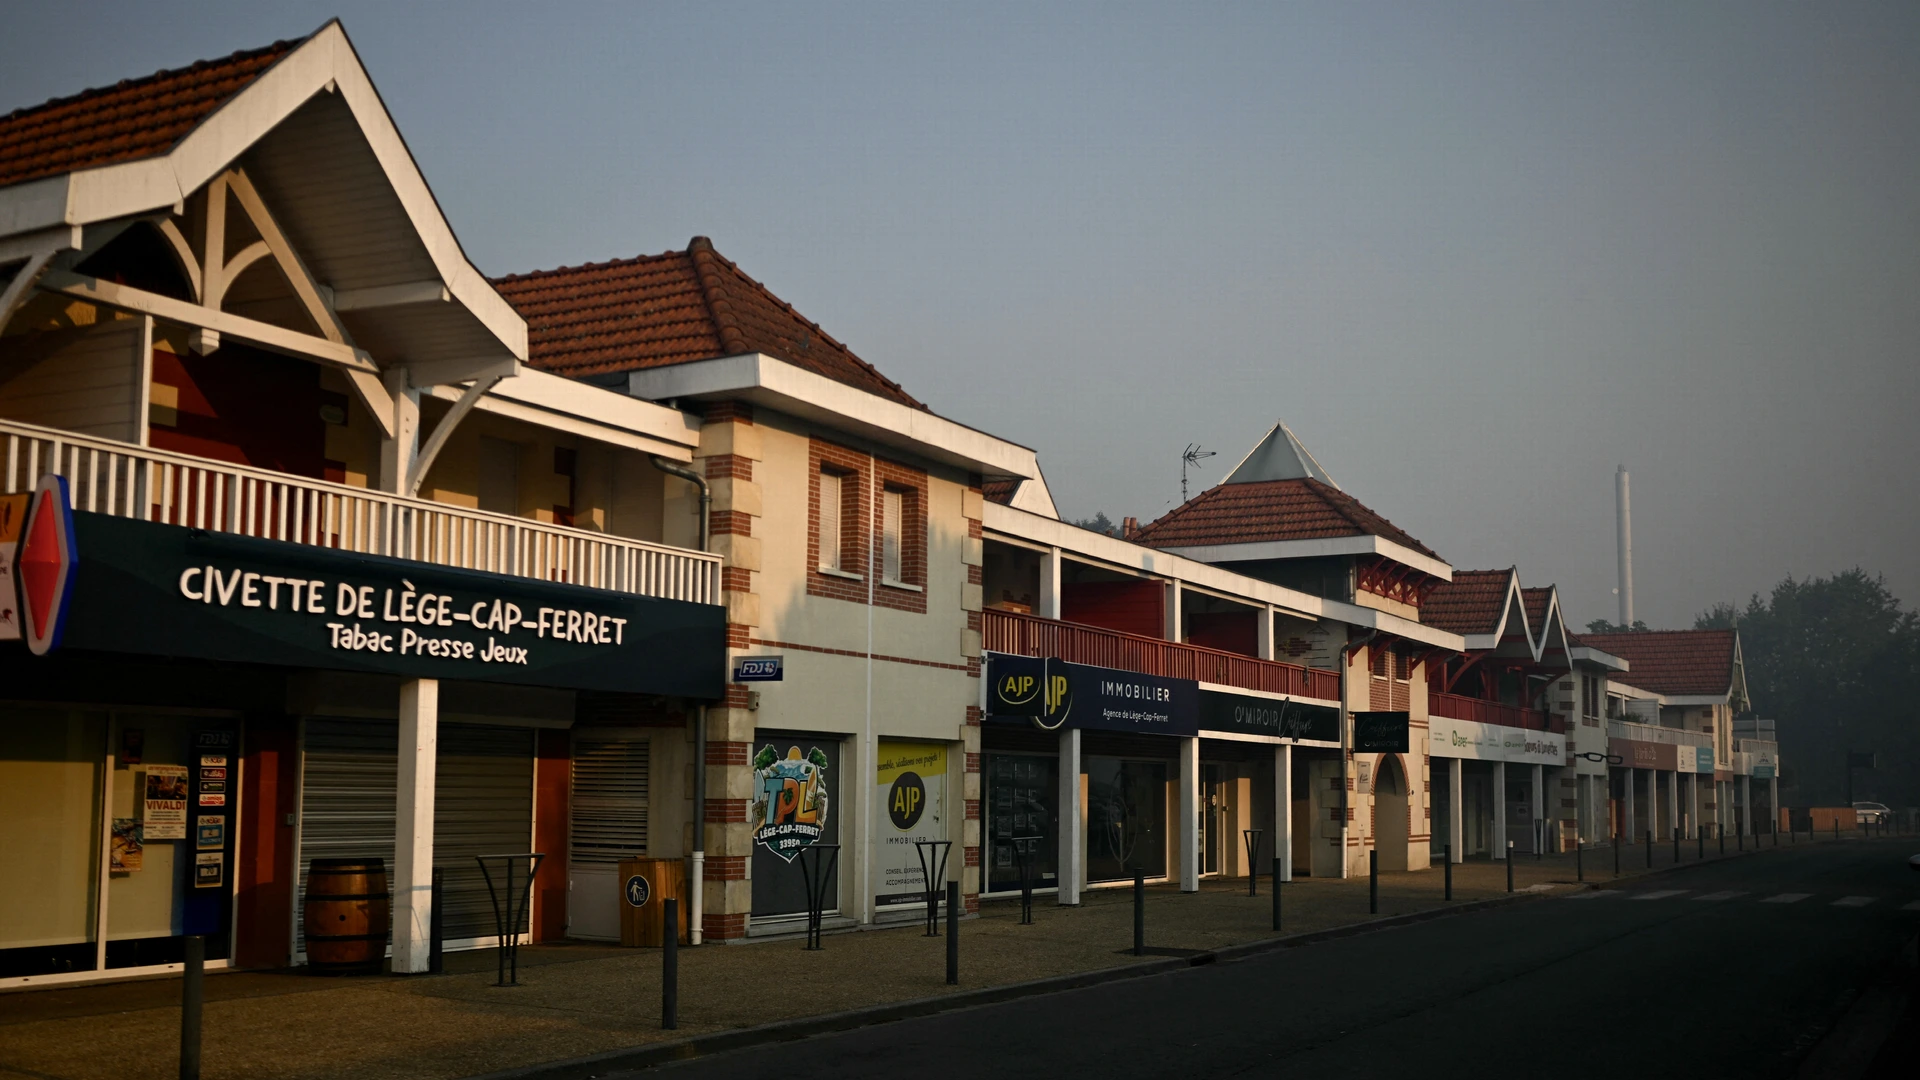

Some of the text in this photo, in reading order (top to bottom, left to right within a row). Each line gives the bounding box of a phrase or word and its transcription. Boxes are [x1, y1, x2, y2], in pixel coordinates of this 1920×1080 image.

[179, 565, 627, 646] CIVETTE DE LÈGE-CAP-FERRET
[326, 622, 528, 665] Tabac Presse Jeux
[742, 662, 763, 674] FDJ
[1005, 676, 1034, 698] AJP
[1101, 680, 1170, 702] IMMOBILIER
[1103, 708, 1168, 722] Agence de Lège-Cap-Ferret
[146, 801, 185, 810] VIVALDI
[764, 777, 818, 826] TPL
[893, 786, 921, 820] AJP
[760, 824, 819, 839] LÈGE-CAP-FERRET
[886, 837, 927, 845] IMMOBILIER
